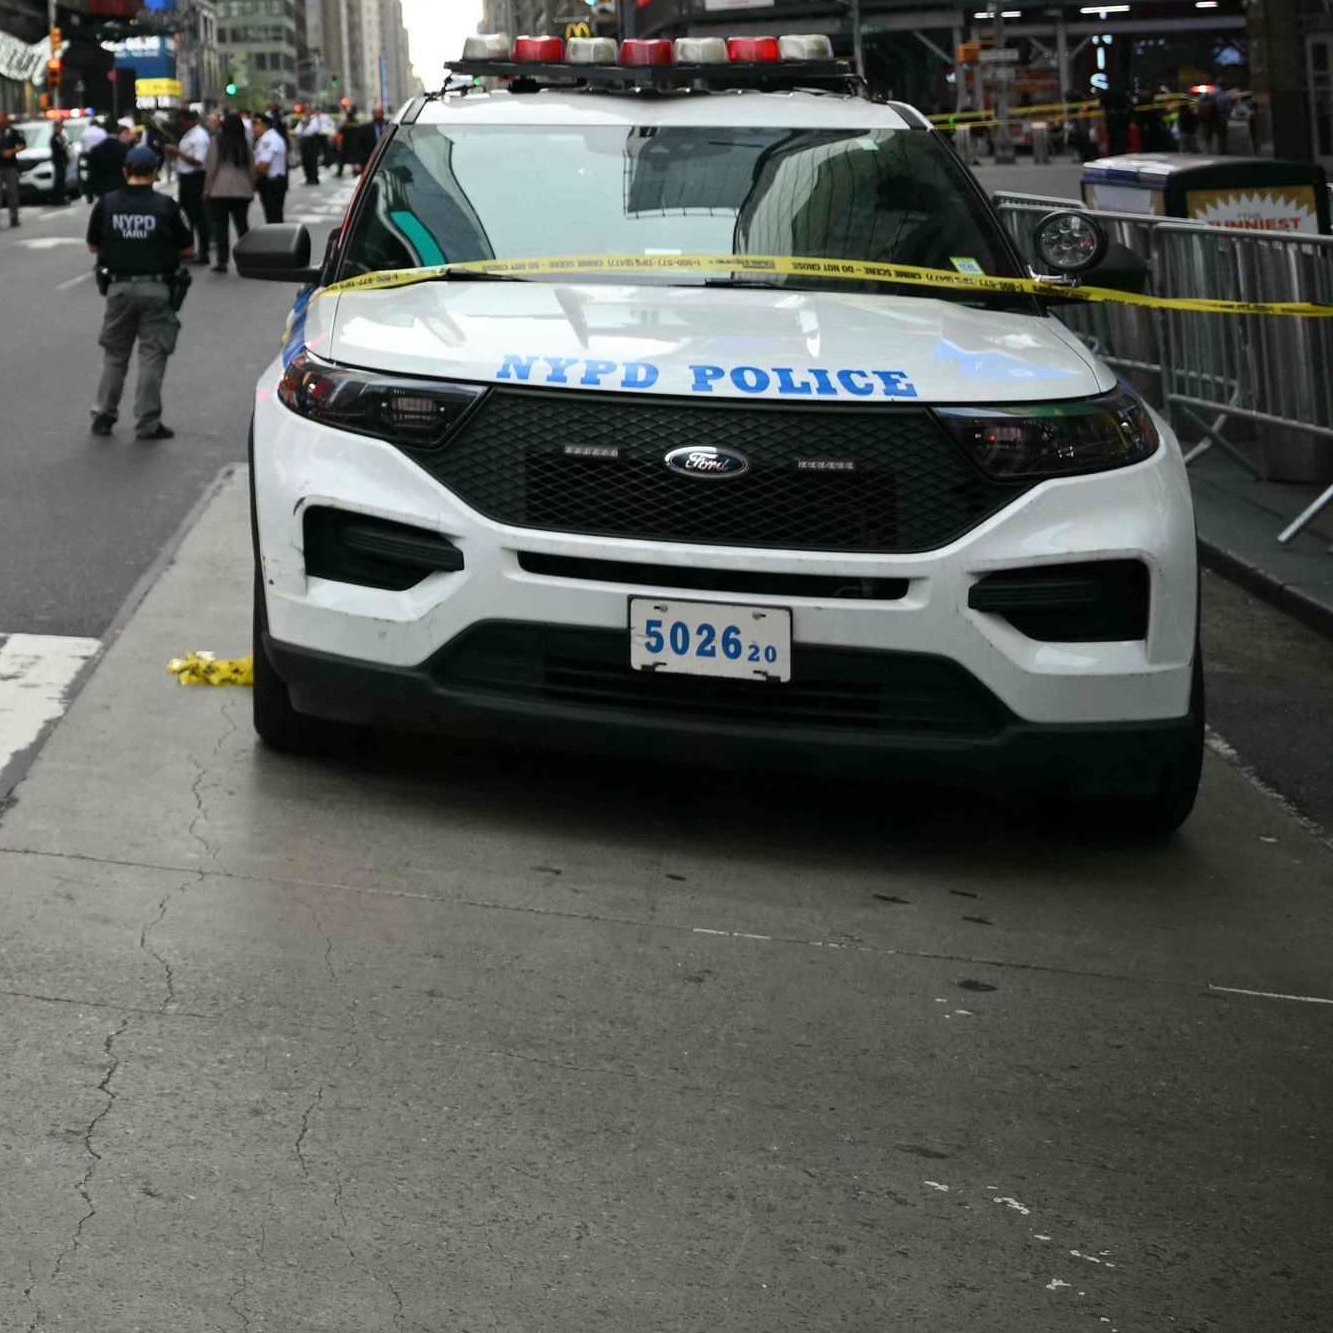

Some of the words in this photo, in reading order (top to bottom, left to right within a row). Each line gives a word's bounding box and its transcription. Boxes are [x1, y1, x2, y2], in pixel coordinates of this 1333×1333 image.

[112, 214, 156, 231] NYPD
[792, 262, 821, 271] CROSS
[823, 264, 841, 272] NOT
[842, 265, 855, 273] DO
[863, 267, 892, 277] SCENE
[894, 269, 922, 280] CRIME
[496, 354, 660, 389] NYPD
[689, 365, 919, 398] POLICE
[685, 453, 732, 474] Ford
